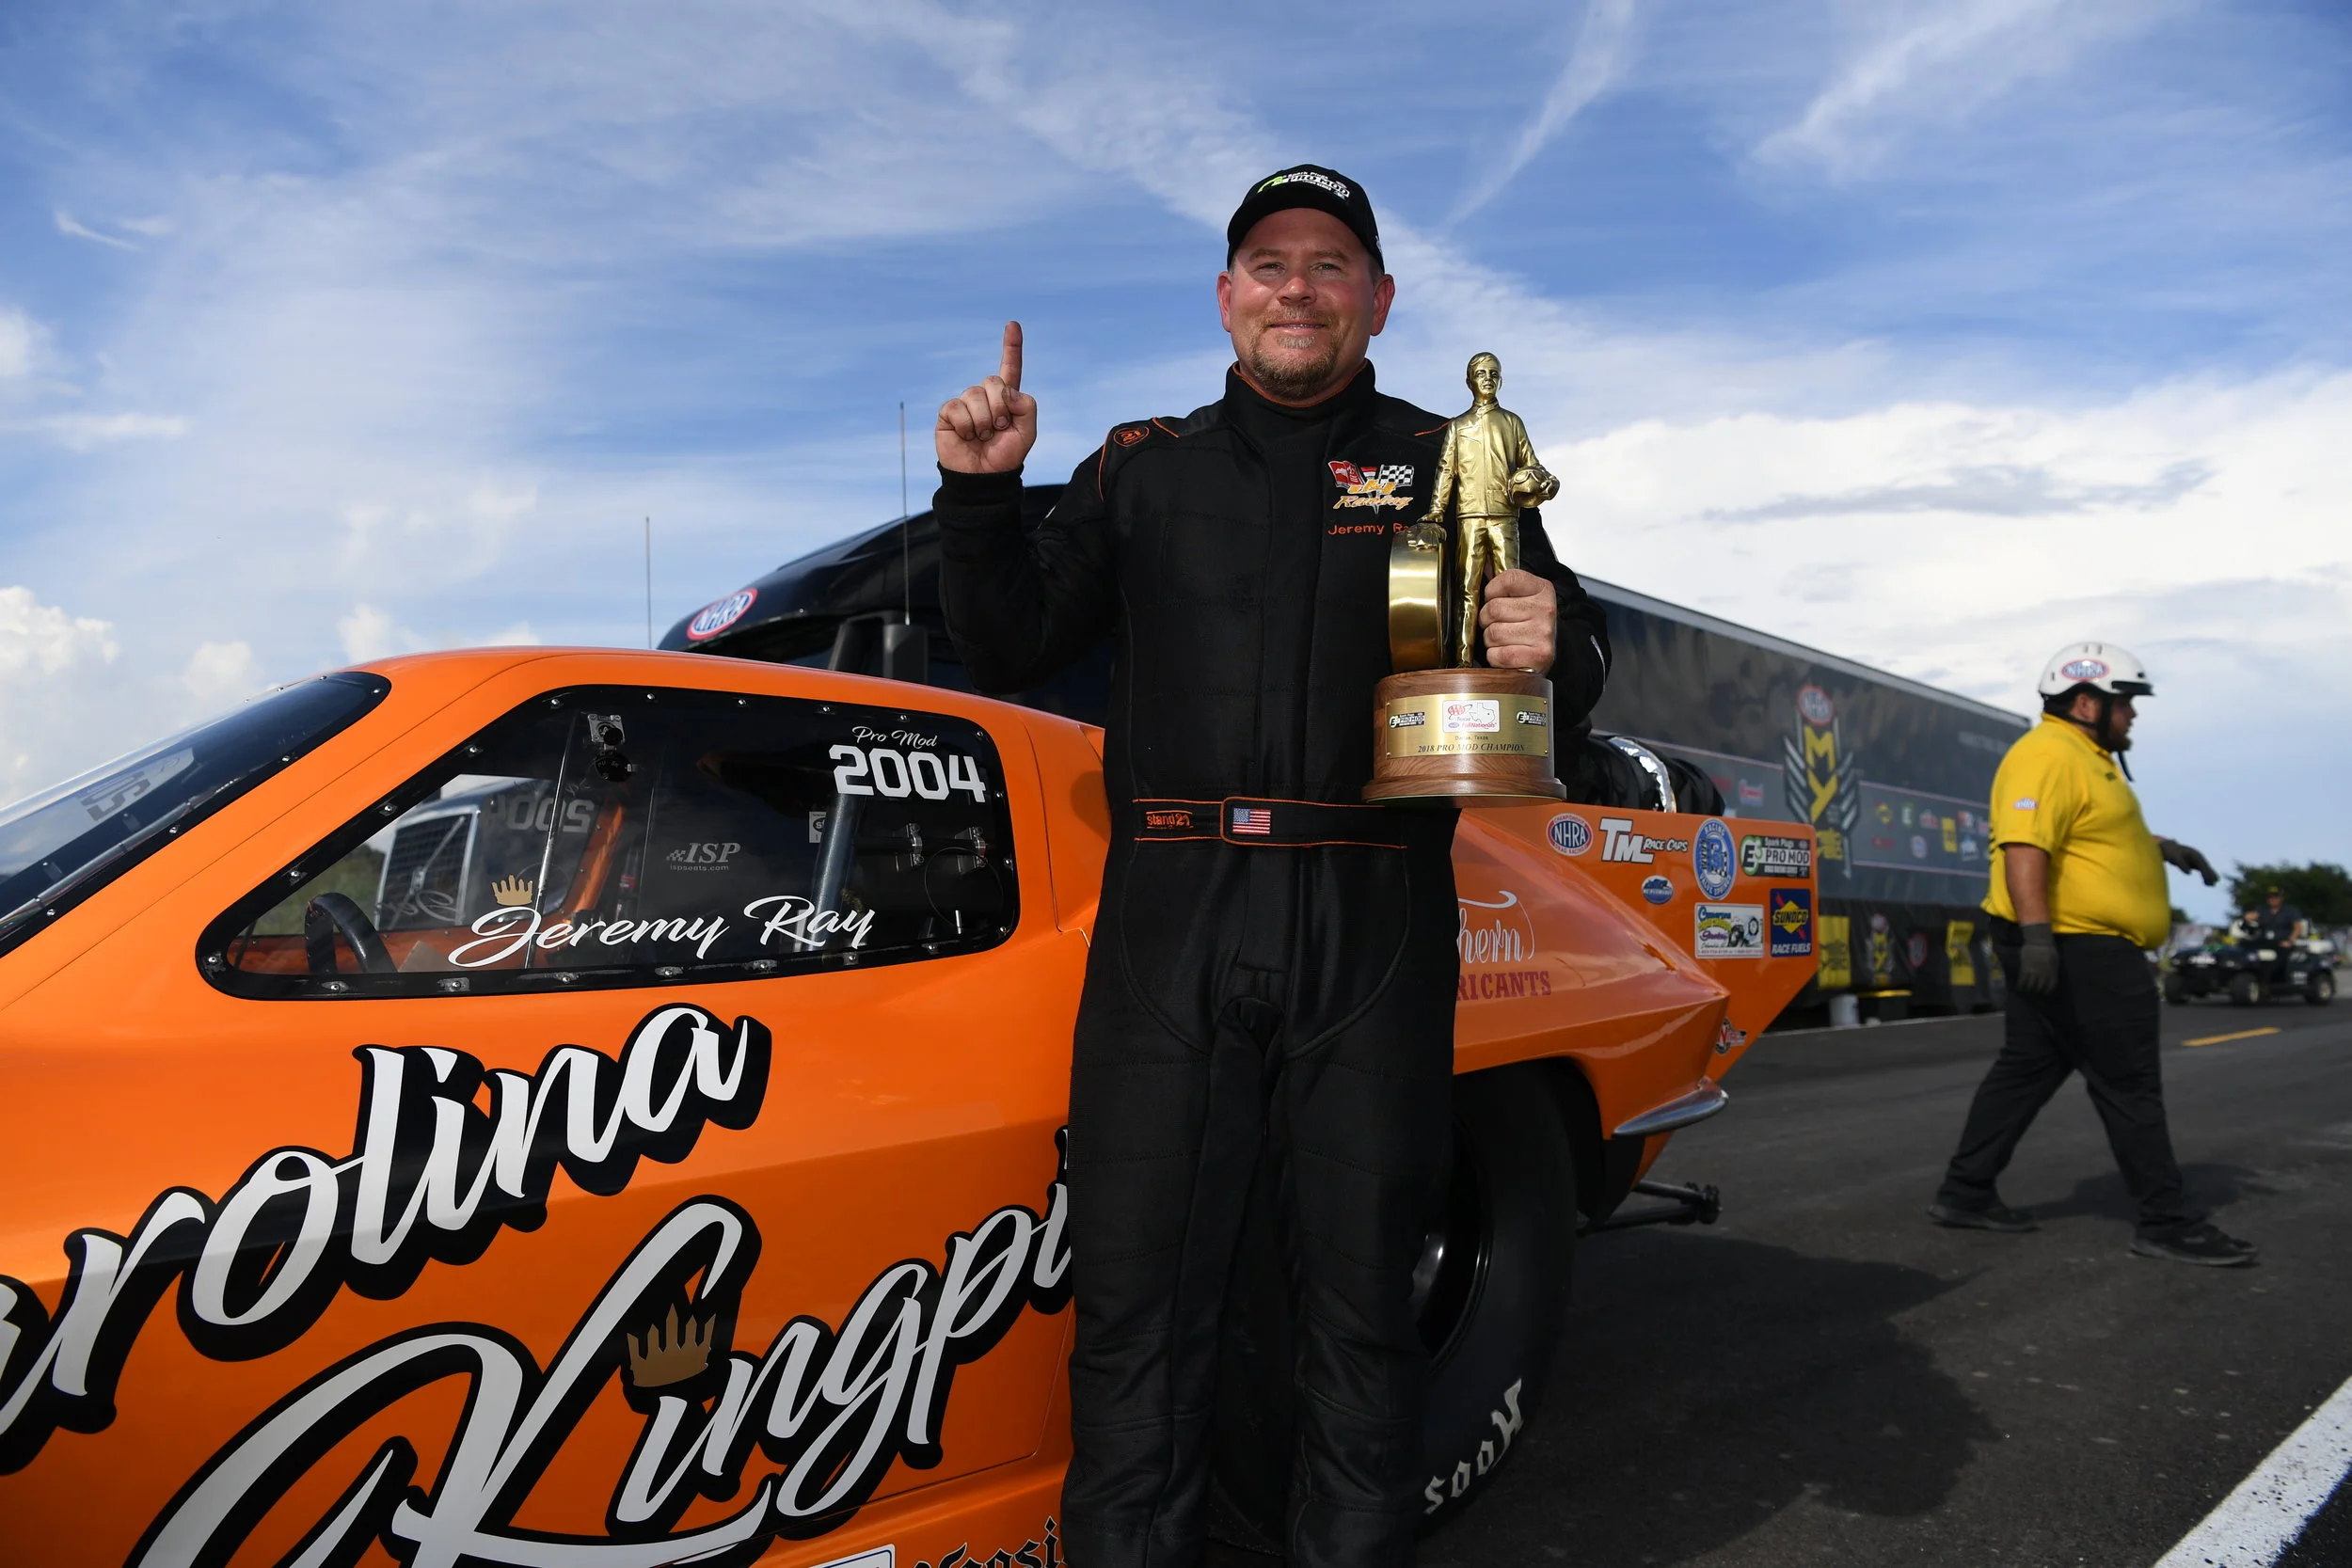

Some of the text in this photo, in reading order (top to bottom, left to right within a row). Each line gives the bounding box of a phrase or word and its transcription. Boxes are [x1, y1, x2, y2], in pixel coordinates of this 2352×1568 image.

[1327, 524, 1385, 535] Jeremy
[851, 725, 938, 750] Pro Mod
[1457, 743, 1478, 752] MOD
[1481, 743, 1525, 752] CHAMPION
[828, 744, 986, 803] 2004
[1554, 822, 1586, 847] NHRA
[1644, 837, 1665, 850] RACE
[1666, 838, 1689, 852] CARS
[684, 843, 741, 863] ISP
[1765, 849, 1809, 863] PRO MOD
[670, 863, 729, 872] ispseats.com
[1774, 911, 1808, 924] SUNOCO
[448, 906, 730, 968] Jeremy
[743, 895, 876, 948] Ray
[1772, 942, 1791, 954] RACE
[1791, 942, 1811, 953] FUELS
